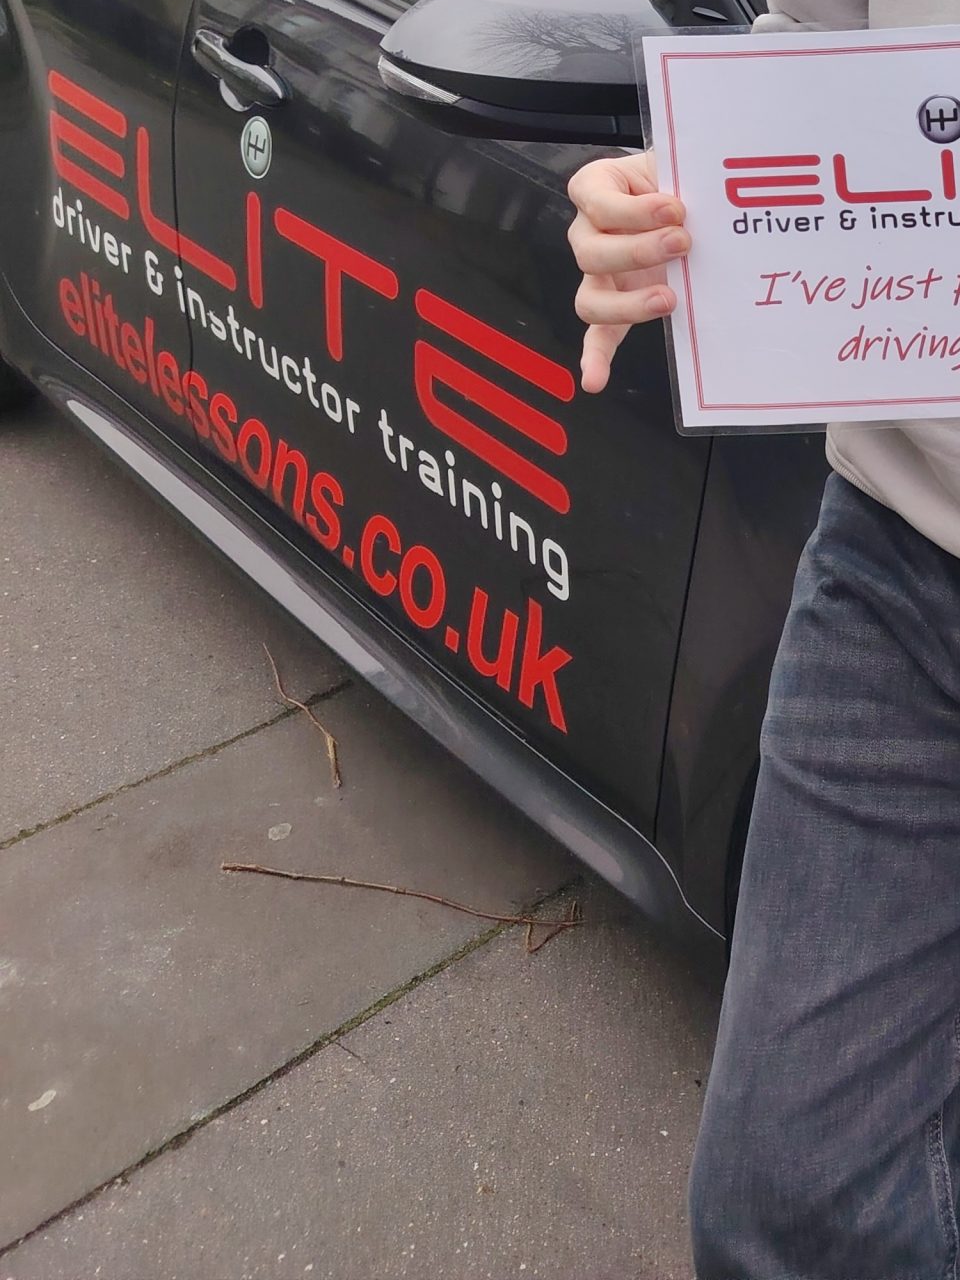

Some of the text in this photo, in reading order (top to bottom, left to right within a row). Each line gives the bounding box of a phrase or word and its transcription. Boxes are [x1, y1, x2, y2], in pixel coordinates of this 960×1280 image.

[48, 70, 575, 514] ELITE
[52, 187, 570, 600] driver & instructor training
[732, 211, 825, 235] driver
[840, 210, 857, 229] &
[755, 270, 846, 307] I've
[851, 265, 943, 310] just
[58, 270, 572, 734] elitelessons.co.uk
